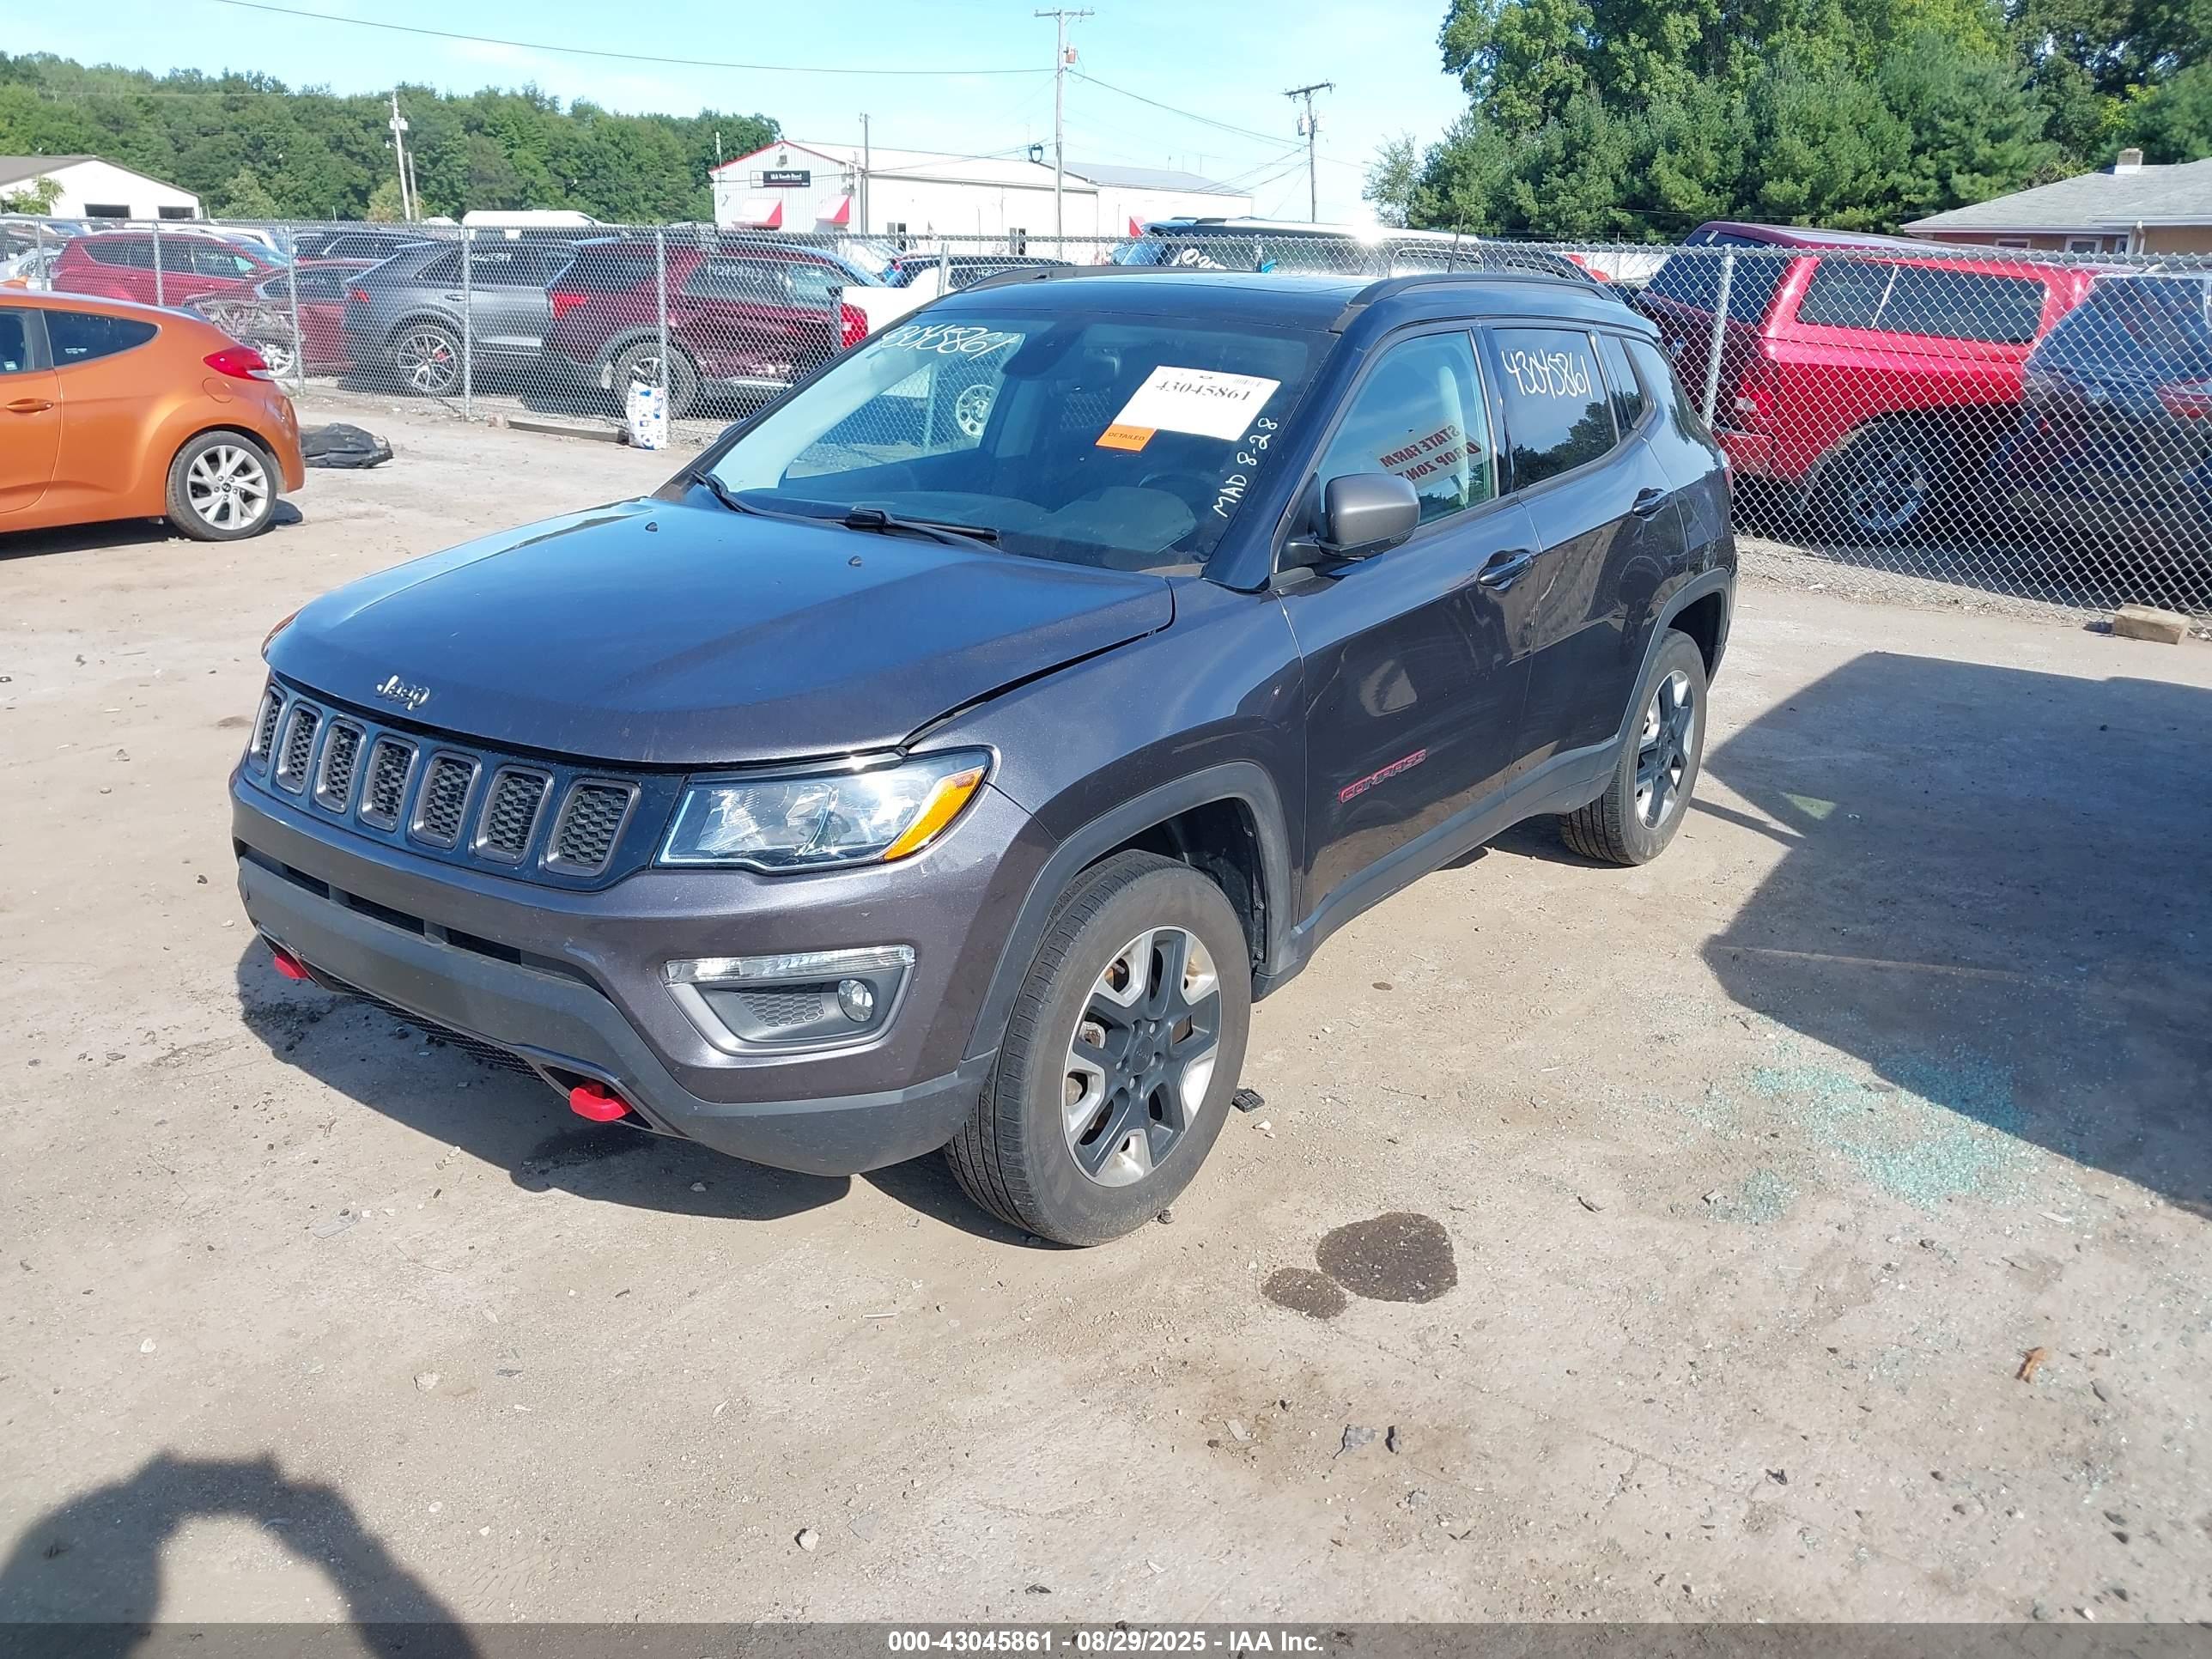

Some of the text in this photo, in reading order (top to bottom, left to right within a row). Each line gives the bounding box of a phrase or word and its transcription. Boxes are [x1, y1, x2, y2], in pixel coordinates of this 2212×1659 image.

[1155, 380, 1252, 402] 43045861
[1500, 347, 1595, 400] 43045861
[1108, 431, 1146, 441] DETAILED
[1212, 416, 1279, 519] MAD 8-28
[376, 674, 430, 711] Jeep
